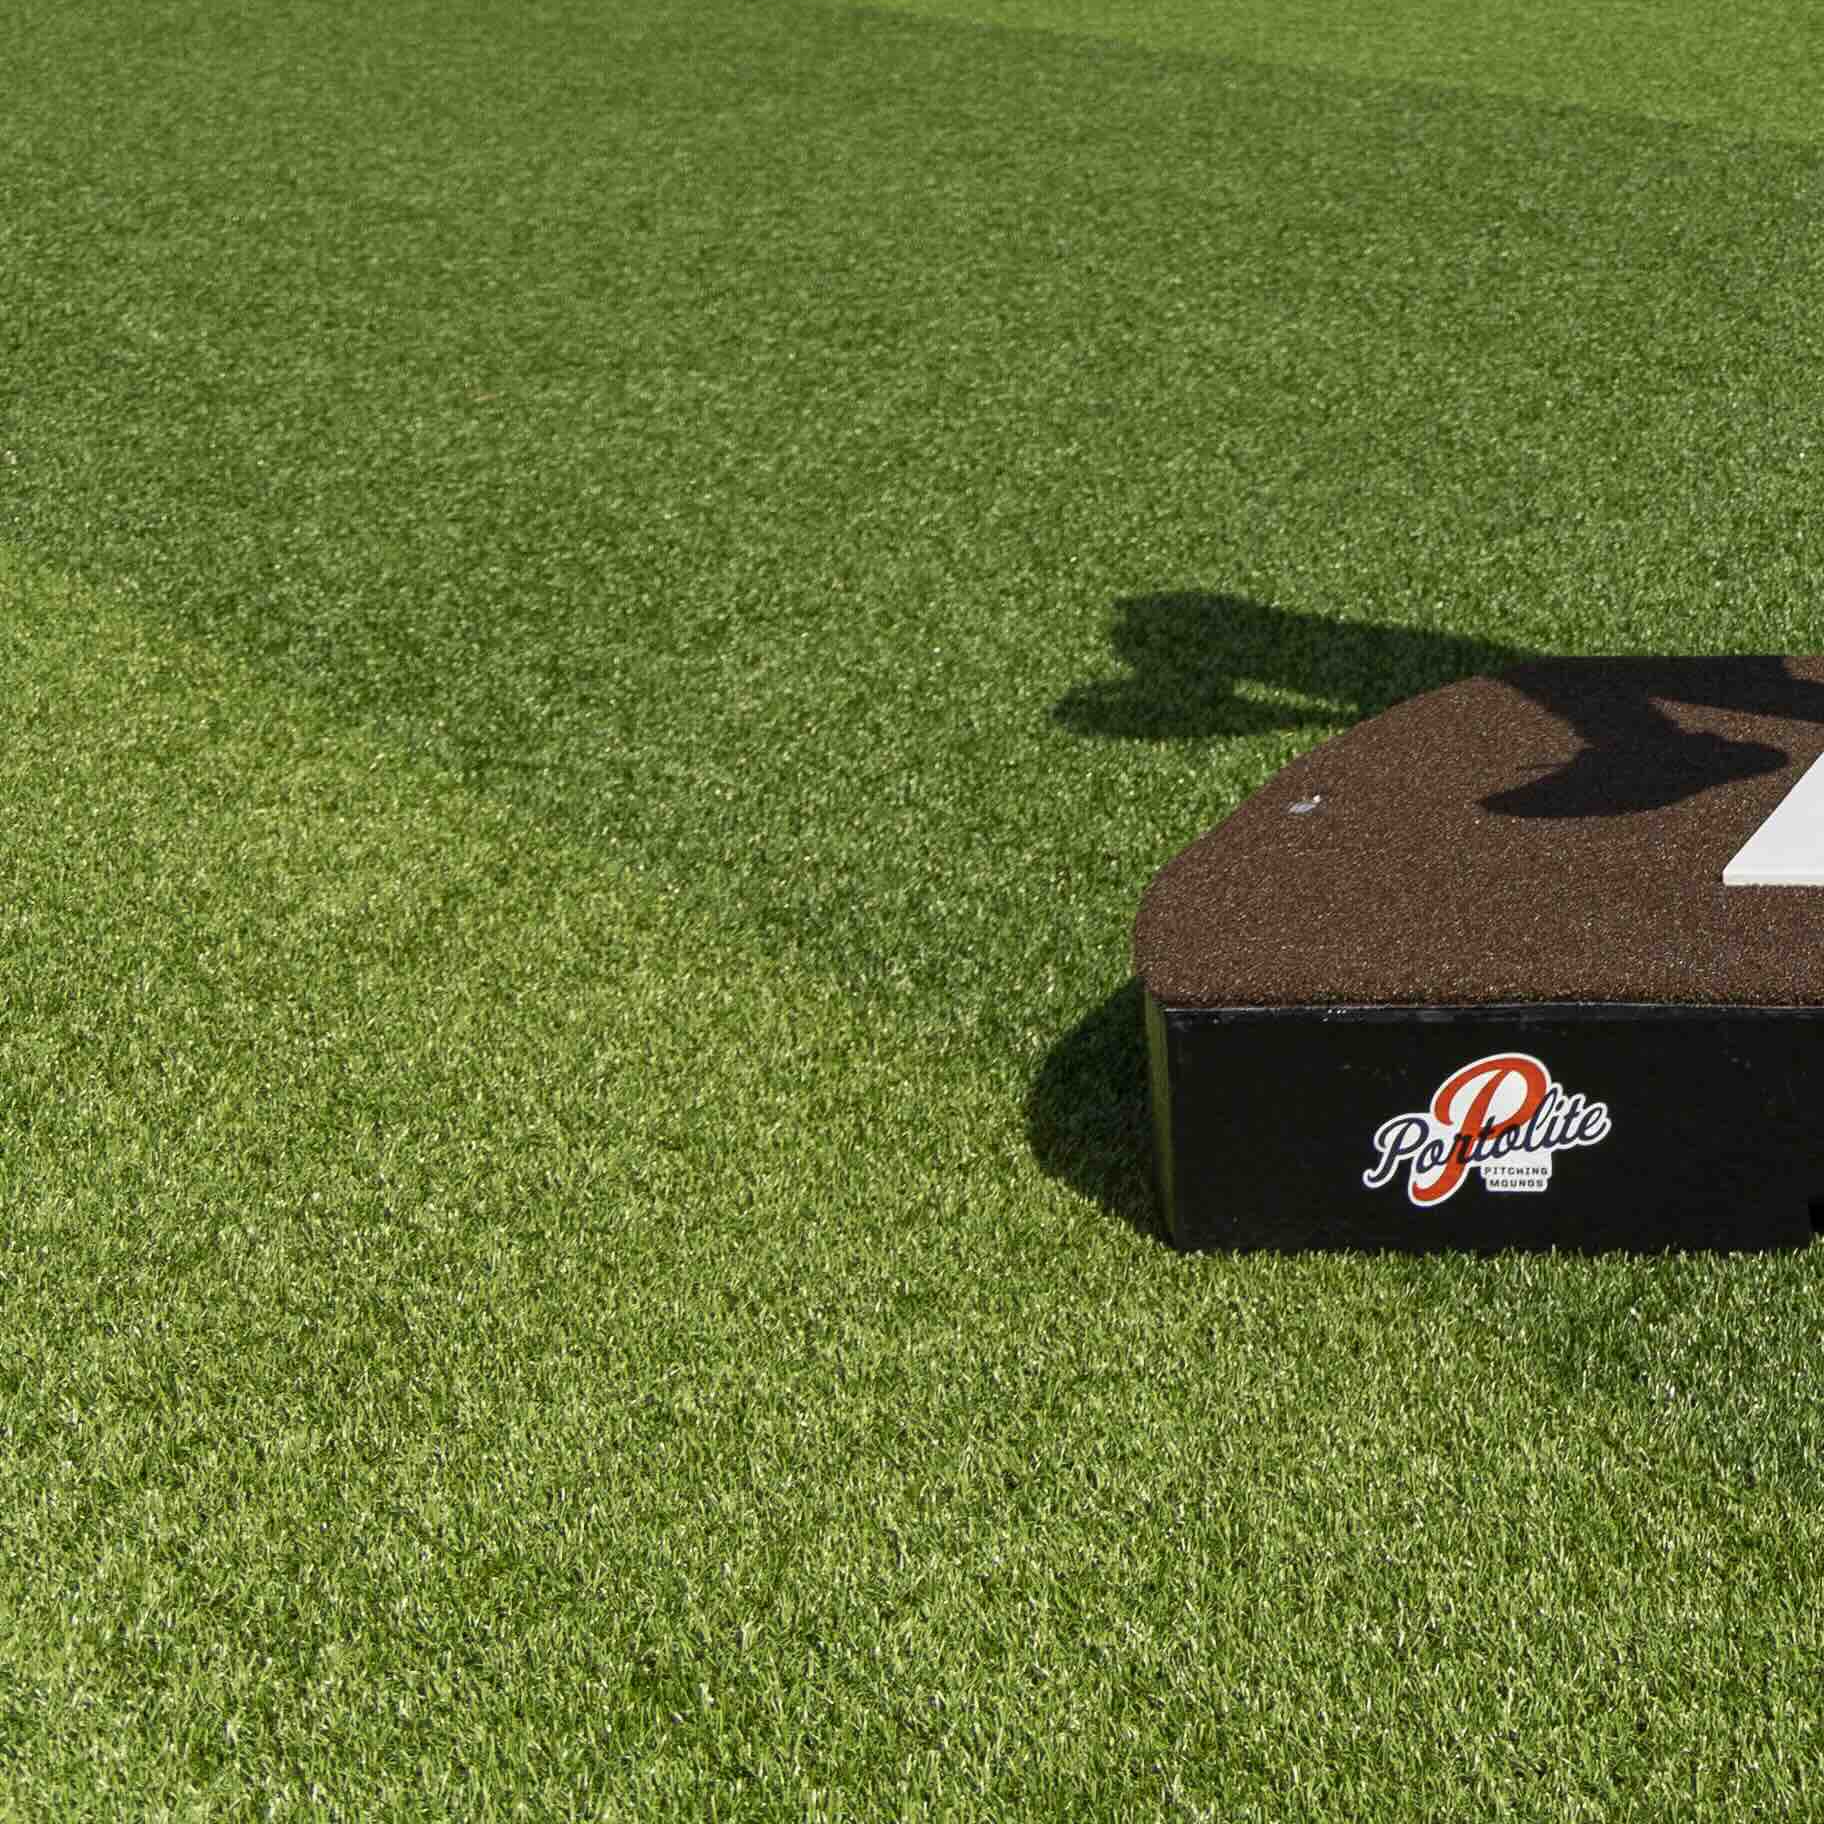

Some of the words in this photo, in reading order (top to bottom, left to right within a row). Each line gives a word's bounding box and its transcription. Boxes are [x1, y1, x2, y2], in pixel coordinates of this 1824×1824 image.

[1366, 1087, 1605, 1184] Portolite
[1485, 1166, 1548, 1176] PITCHING
[1489, 1178, 1544, 1188] MOUNDS
